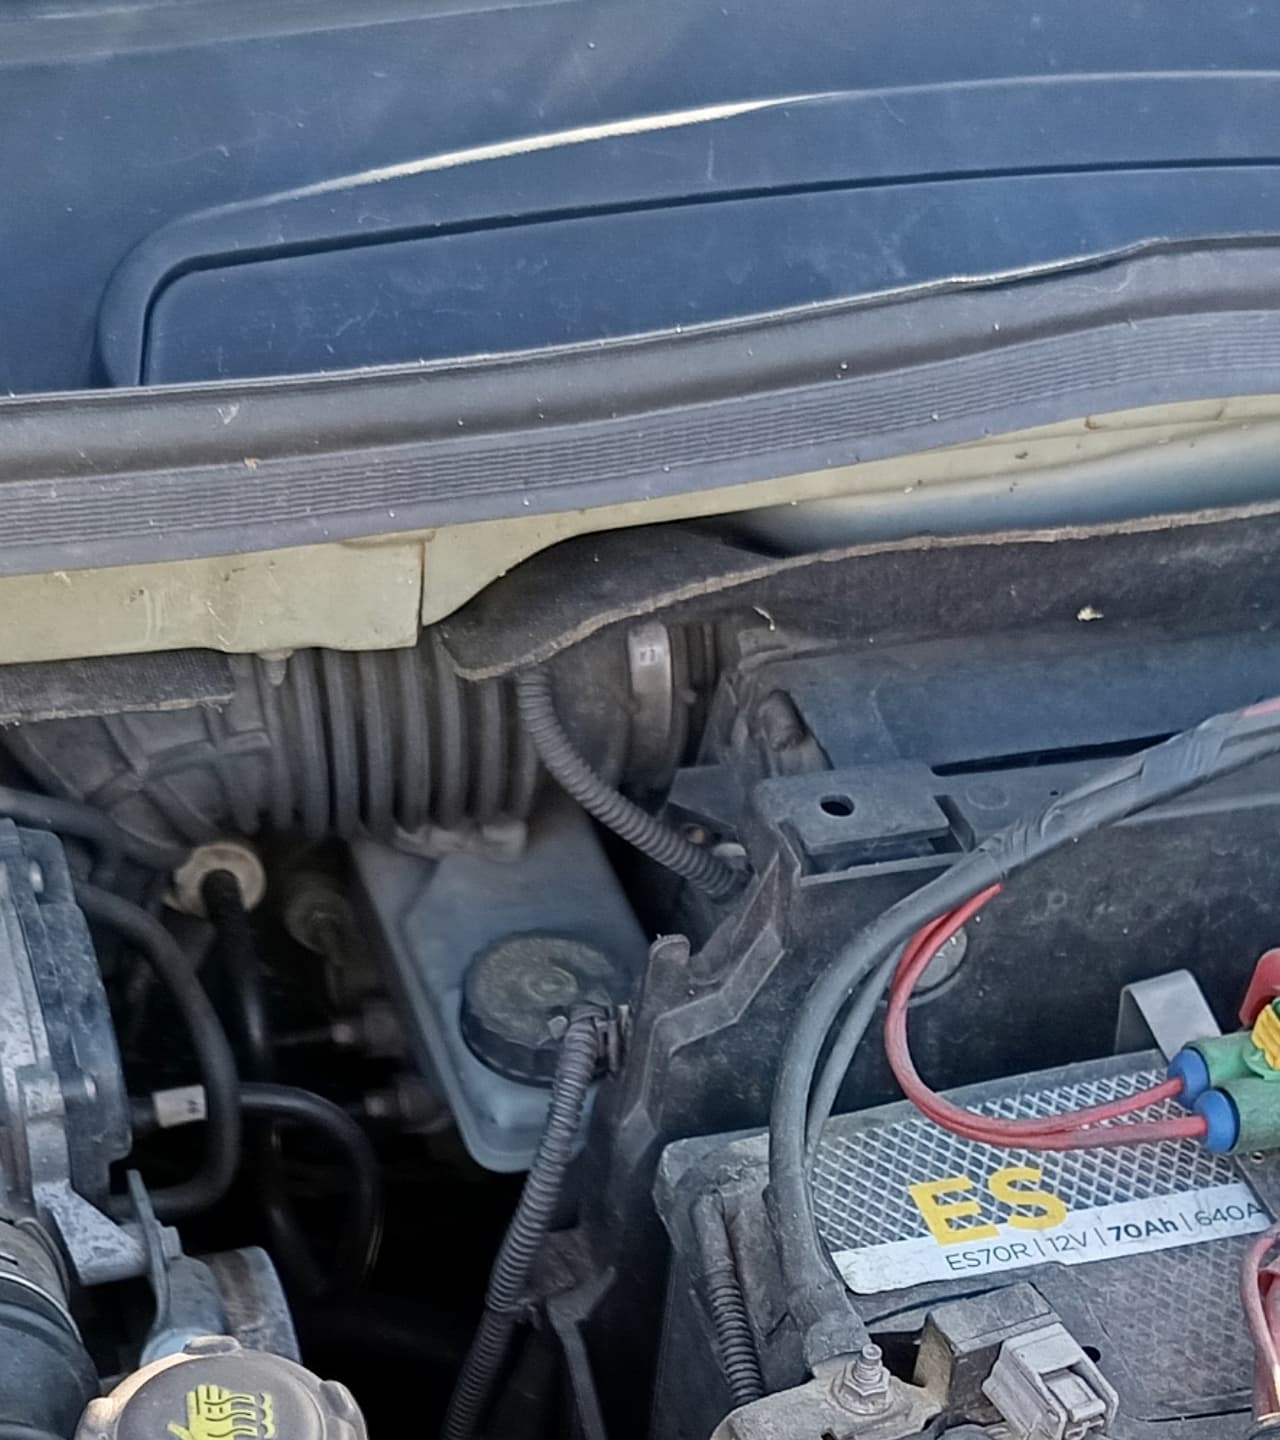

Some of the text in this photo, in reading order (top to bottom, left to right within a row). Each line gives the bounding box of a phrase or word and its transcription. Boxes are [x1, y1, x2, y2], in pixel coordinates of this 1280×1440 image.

[908, 1167, 1067, 1247] ES
[945, 1203, 1266, 1272] ES70R 12V 70Ah 640A
